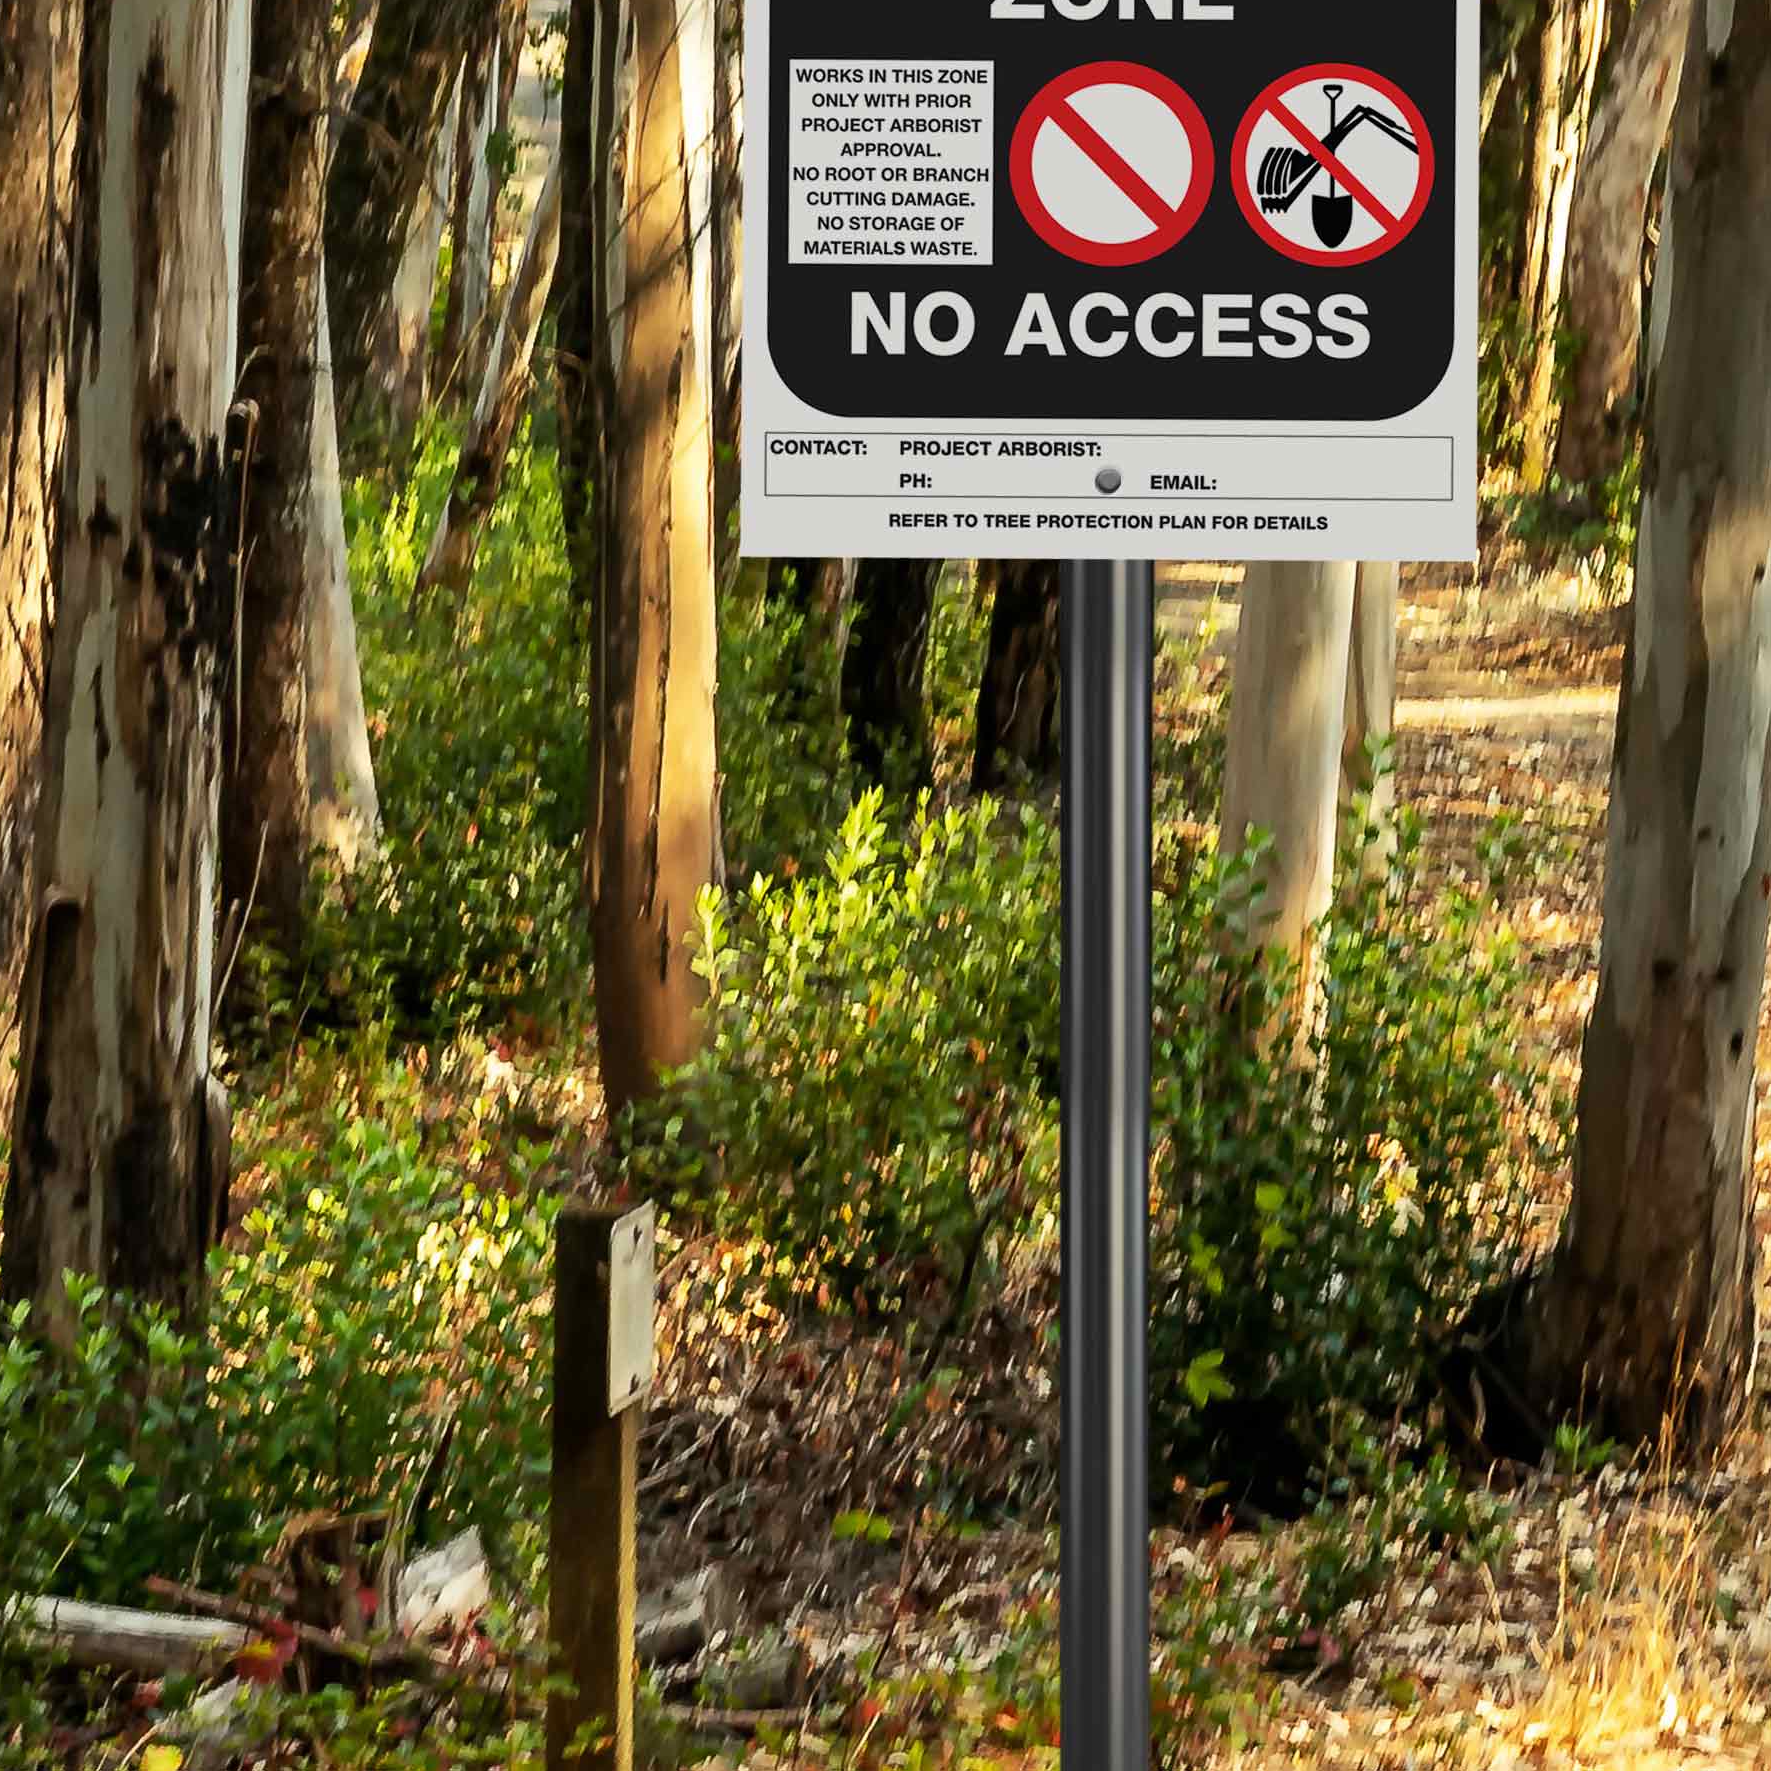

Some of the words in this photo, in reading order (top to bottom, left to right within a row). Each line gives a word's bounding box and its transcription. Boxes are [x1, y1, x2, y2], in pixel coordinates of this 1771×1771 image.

[796, 69, 863, 83] WORKS
[869, 69, 886, 83] IN
[892, 69, 932, 83] THIS
[938, 70, 987, 83] ZONE
[812, 93, 859, 107] ONLY
[864, 94, 909, 108] WITH
[916, 94, 971, 108] PRIOR
[802, 118, 885, 132] PROJECT
[890, 119, 982, 133] ARBORIST
[841, 143, 941, 157] APPROVAL.
[794, 167, 819, 181] NO
[826, 167, 876, 181] ROOT
[881, 168, 907, 181] OR
[914, 168, 988, 182] BRANCH
[807, 192, 885, 206] CUTTING
[892, 192, 975, 206] DAMAGE.
[818, 216, 844, 230] NO
[849, 216, 935, 231] STORAGE
[941, 217, 964, 231] OF
[804, 241, 905, 255] MATERIALS
[910, 242, 977, 255] WASTE.
[851, 291, 975, 356] NO
[1004, 292, 1370, 358] ACCESS
[771, 440, 867, 455] CONTACT:
[900, 441, 992, 456] PROJECT
[998, 442, 1101, 456] ARBORIST:
[900, 474, 932, 488] PH:
[1151, 475, 1216, 490] EMAIL:
[890, 514, 947, 527] REFER
[953, 514, 978, 527] TO
[984, 514, 1030, 528] TREE
[1037, 515, 1152, 529] PROTECTION
[1160, 516, 1205, 529] PLAN
[1212, 516, 1248, 529] FOR
[1254, 516, 1328, 530] DETAILS
